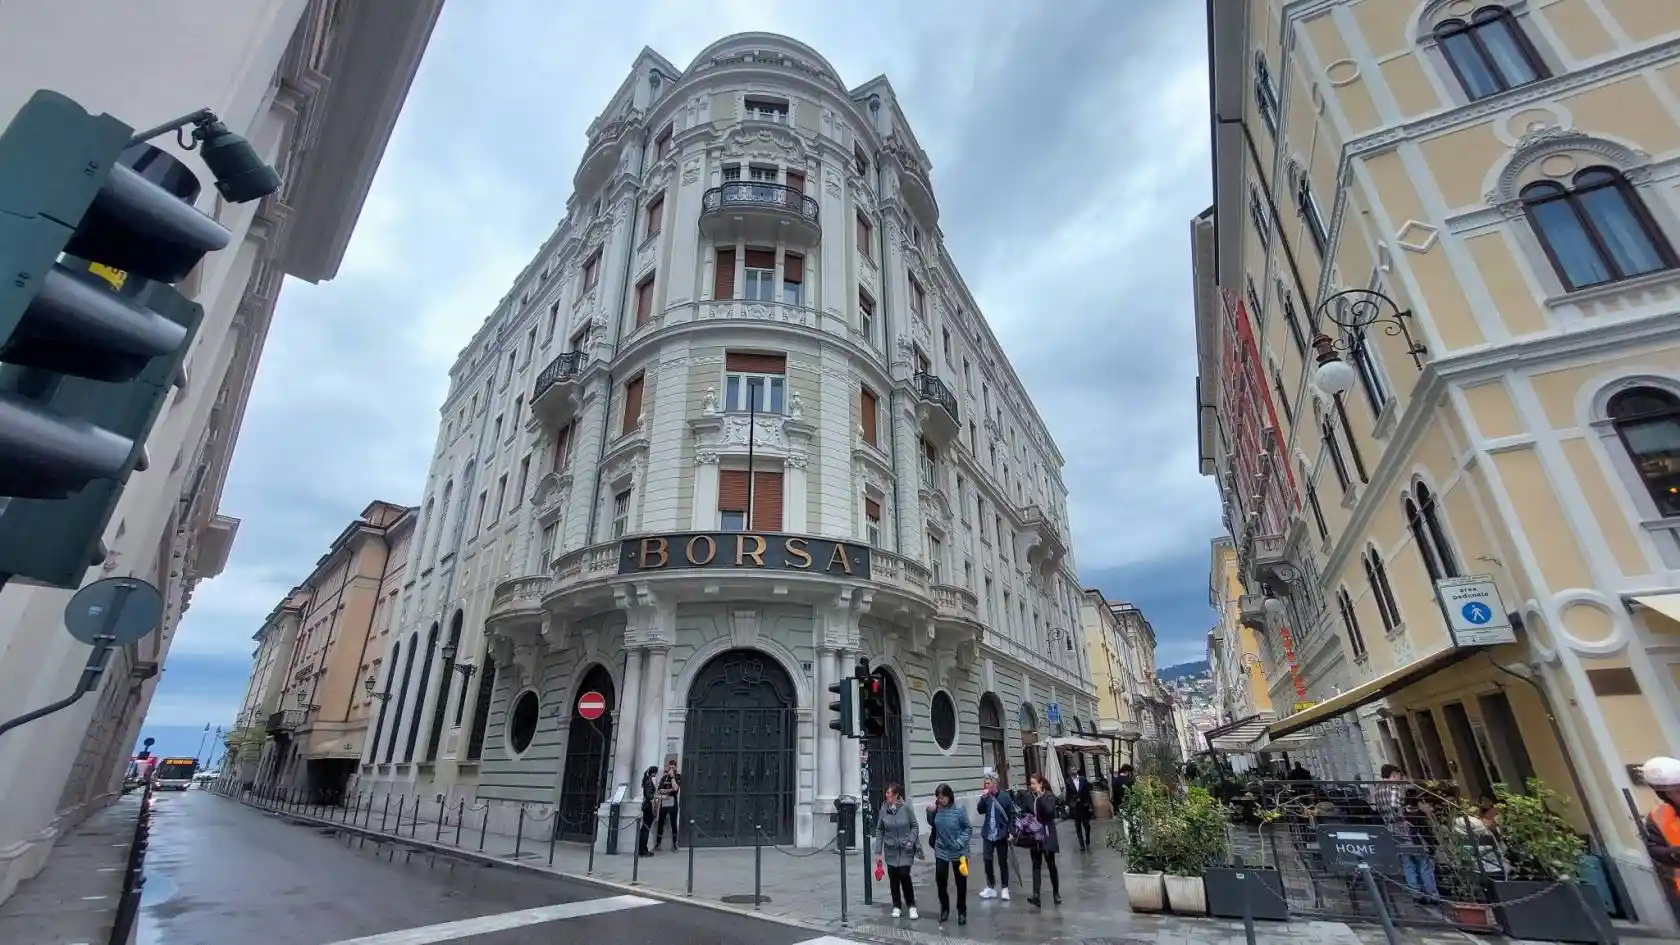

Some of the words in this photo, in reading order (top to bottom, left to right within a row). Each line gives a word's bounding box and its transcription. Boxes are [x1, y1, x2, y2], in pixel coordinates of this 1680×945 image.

[639, 534, 852, 575] BORSA
[1452, 592, 1489, 600] pedonale
[1335, 844, 1377, 855] HOME
